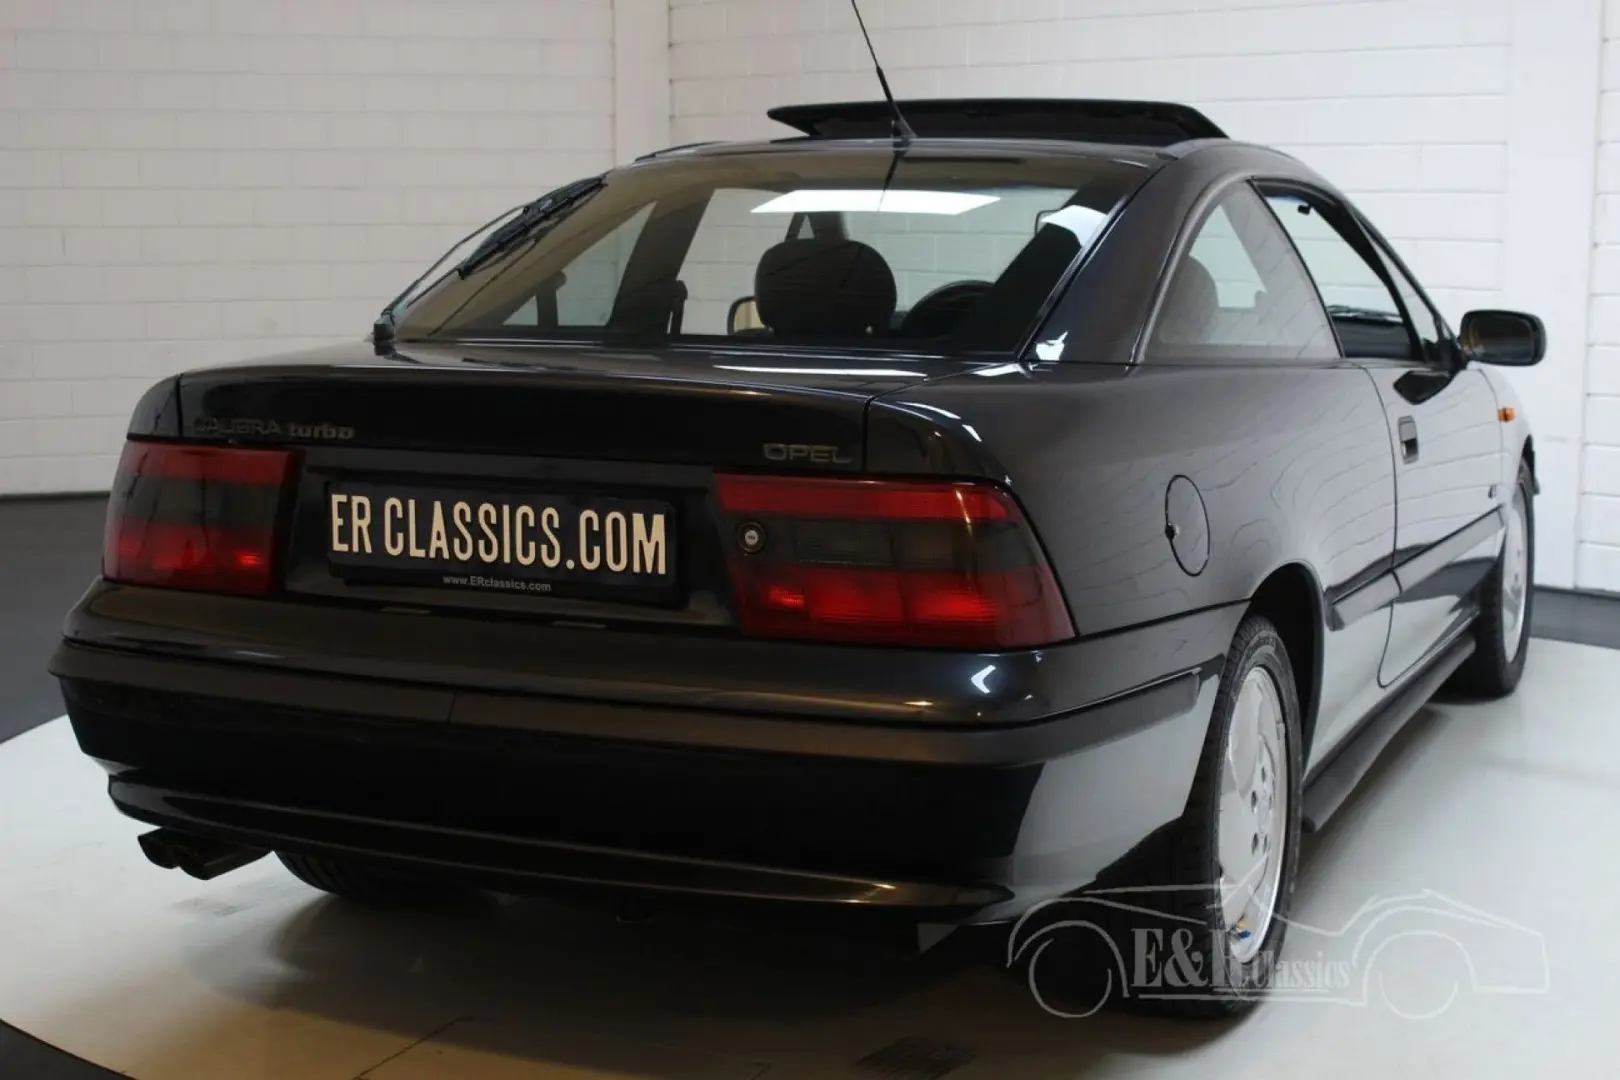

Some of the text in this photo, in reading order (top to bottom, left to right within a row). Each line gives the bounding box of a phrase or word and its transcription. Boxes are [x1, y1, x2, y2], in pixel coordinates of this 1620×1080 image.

[287, 421, 354, 440] turbo
[763, 443, 852, 463] OPEL
[331, 494, 666, 574] ER CLASSICS.COM
[442, 575, 552, 592] www.ERclassics.com
